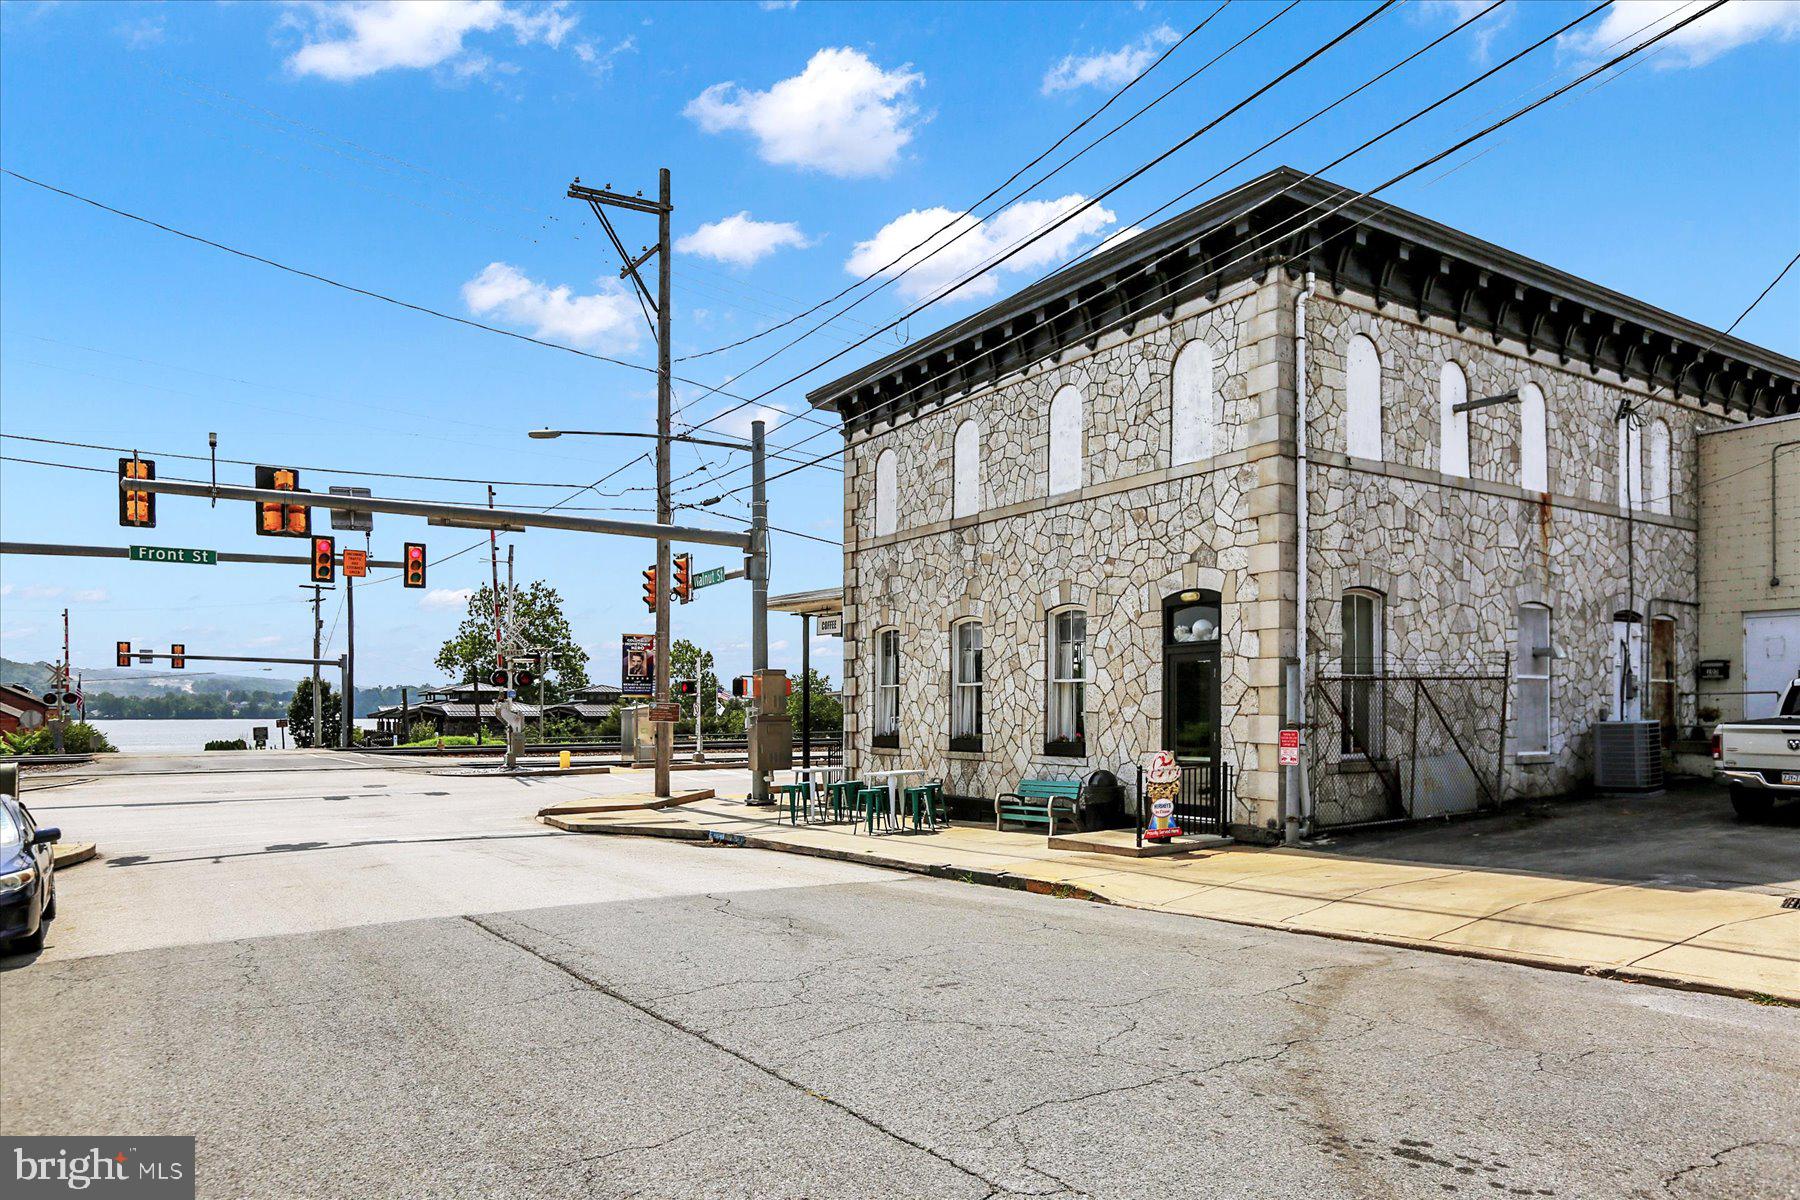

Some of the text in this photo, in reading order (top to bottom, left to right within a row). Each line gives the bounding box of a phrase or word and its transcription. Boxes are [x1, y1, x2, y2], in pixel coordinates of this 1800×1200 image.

[139, 547, 208, 562] Front St
[693, 568, 724, 588] Walnut St
[822, 620, 837, 630] COFFEE
